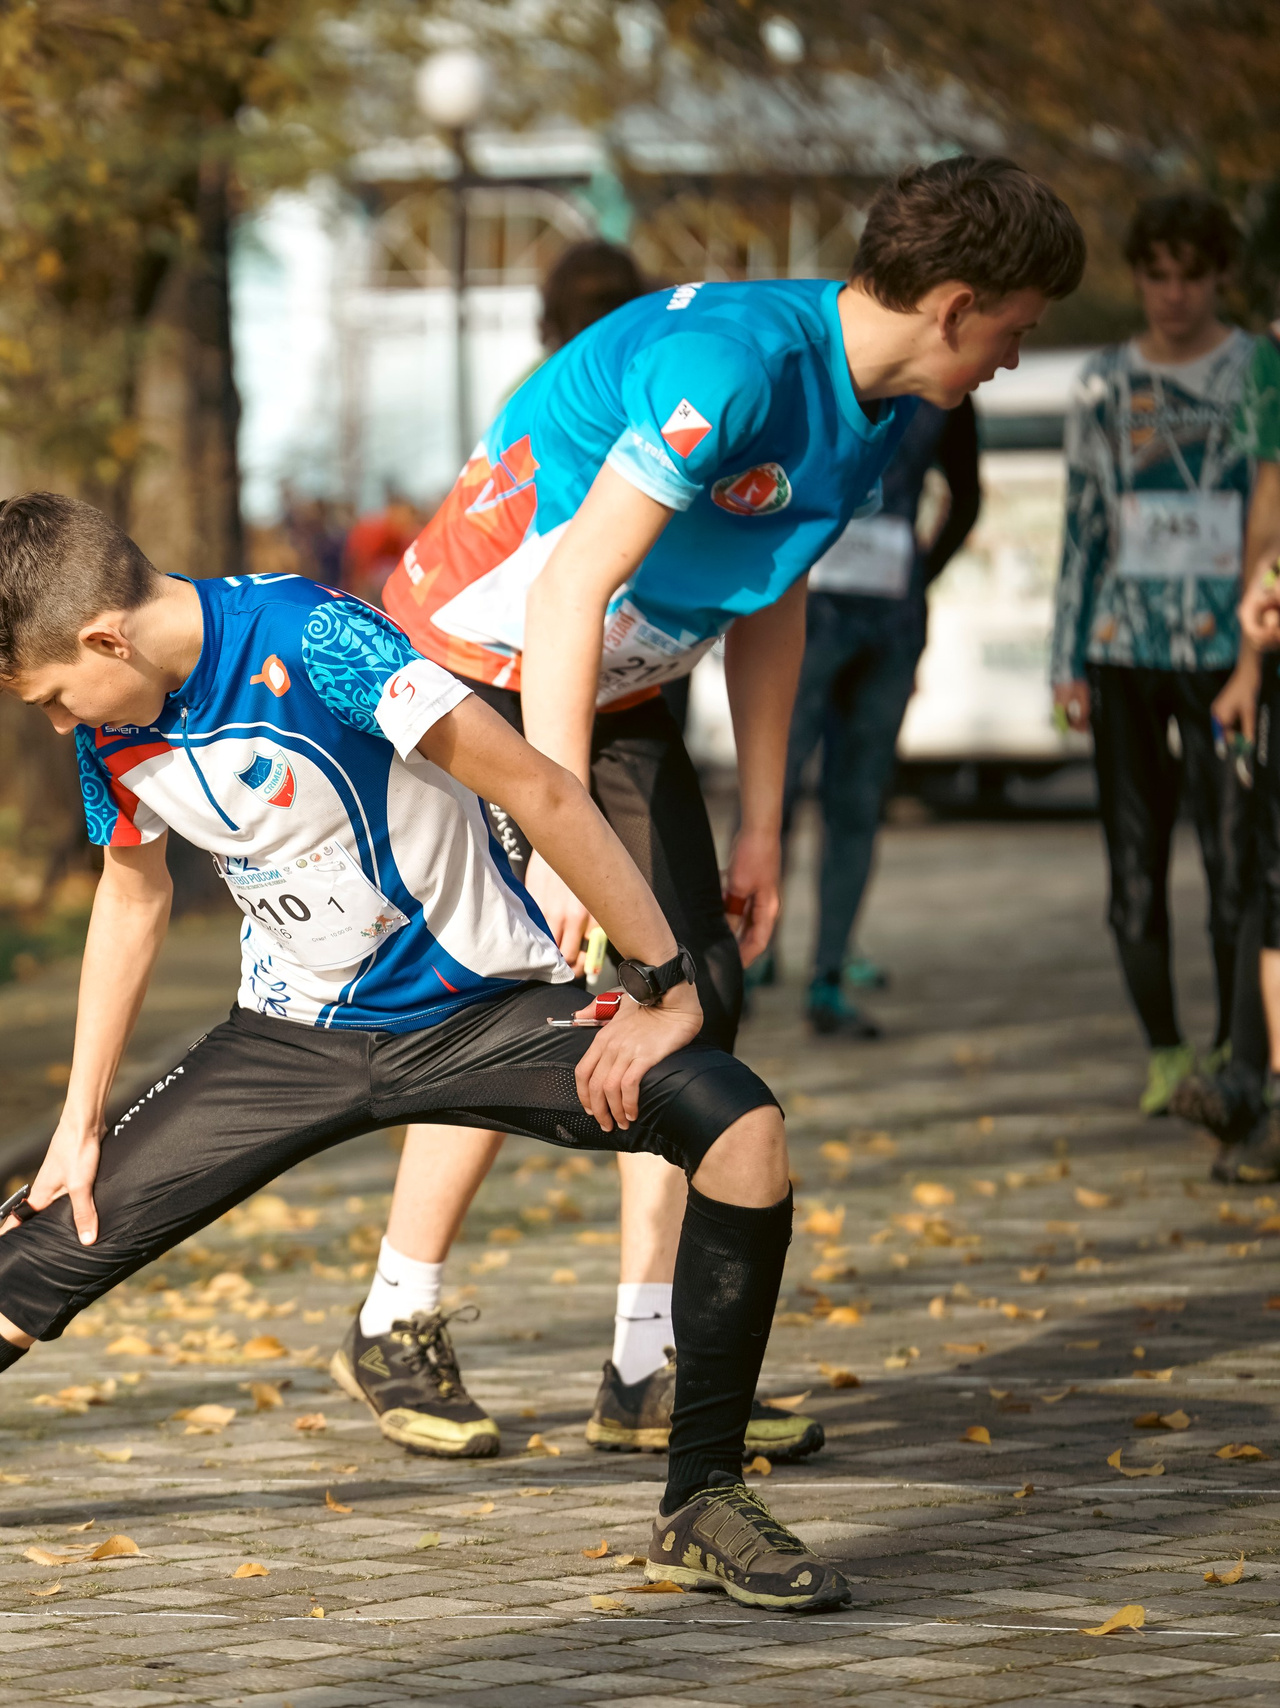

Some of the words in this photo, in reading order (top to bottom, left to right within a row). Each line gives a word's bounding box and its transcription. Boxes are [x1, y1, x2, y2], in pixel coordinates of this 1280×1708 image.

[264, 763, 283, 794] CRIMEA
[247, 868, 283, 884] РОССИИ
[236, 893, 312, 926] 210
[327, 895, 345, 914] 1
